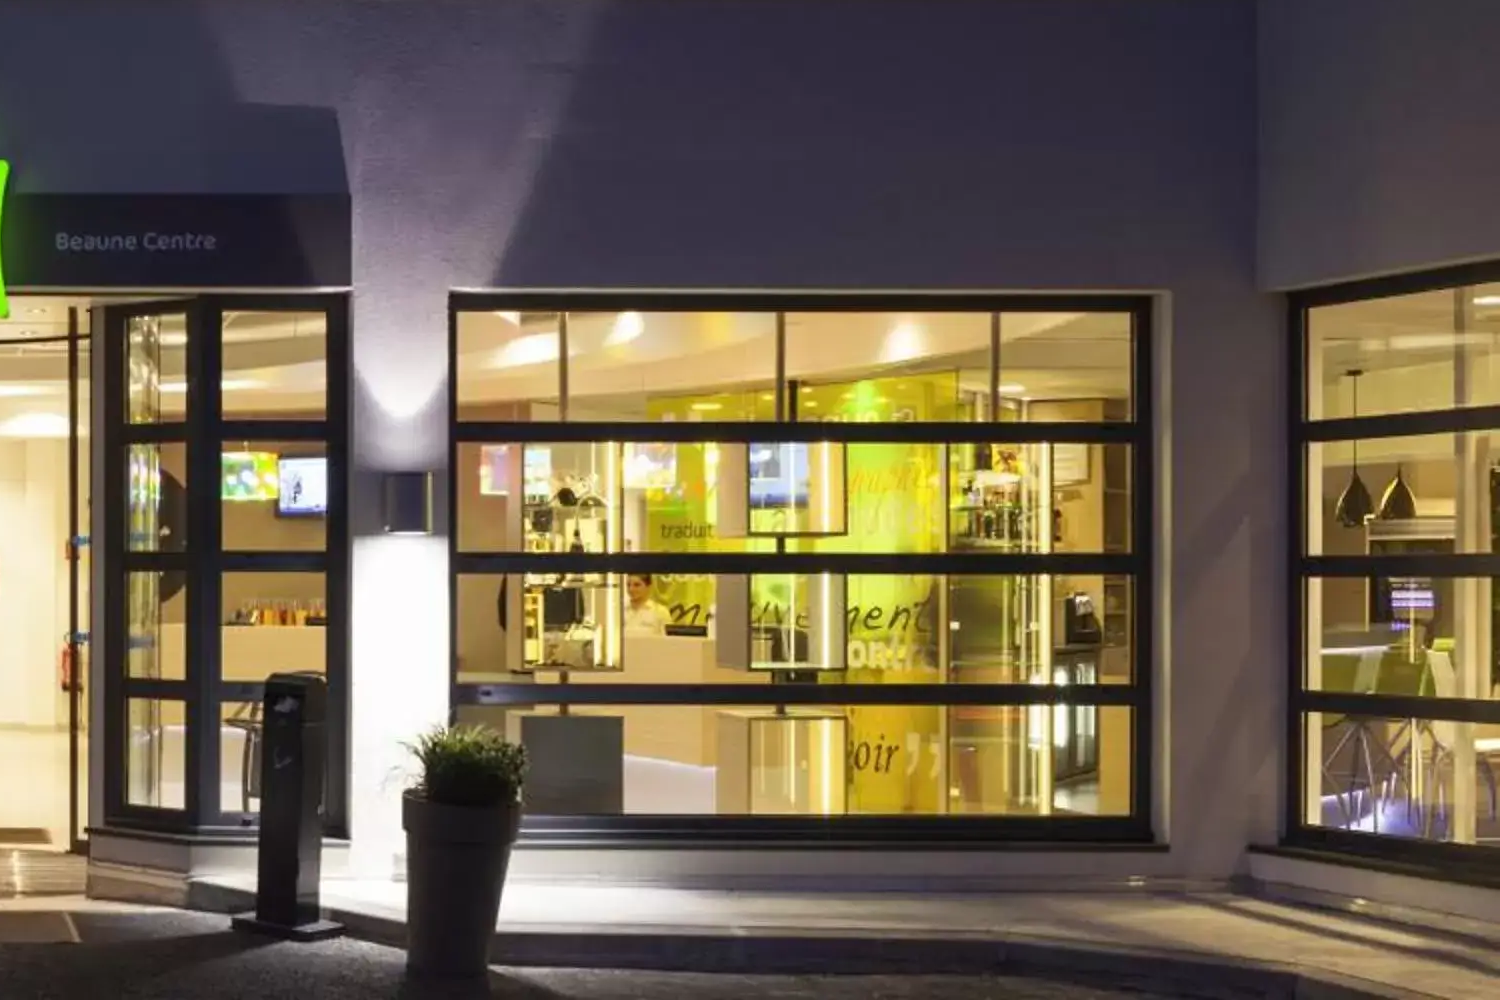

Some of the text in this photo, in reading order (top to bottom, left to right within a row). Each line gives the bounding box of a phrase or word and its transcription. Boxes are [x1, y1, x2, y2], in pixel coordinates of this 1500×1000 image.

[55, 232, 217, 250] Beaune Centre
[661, 521, 715, 539] traduit
